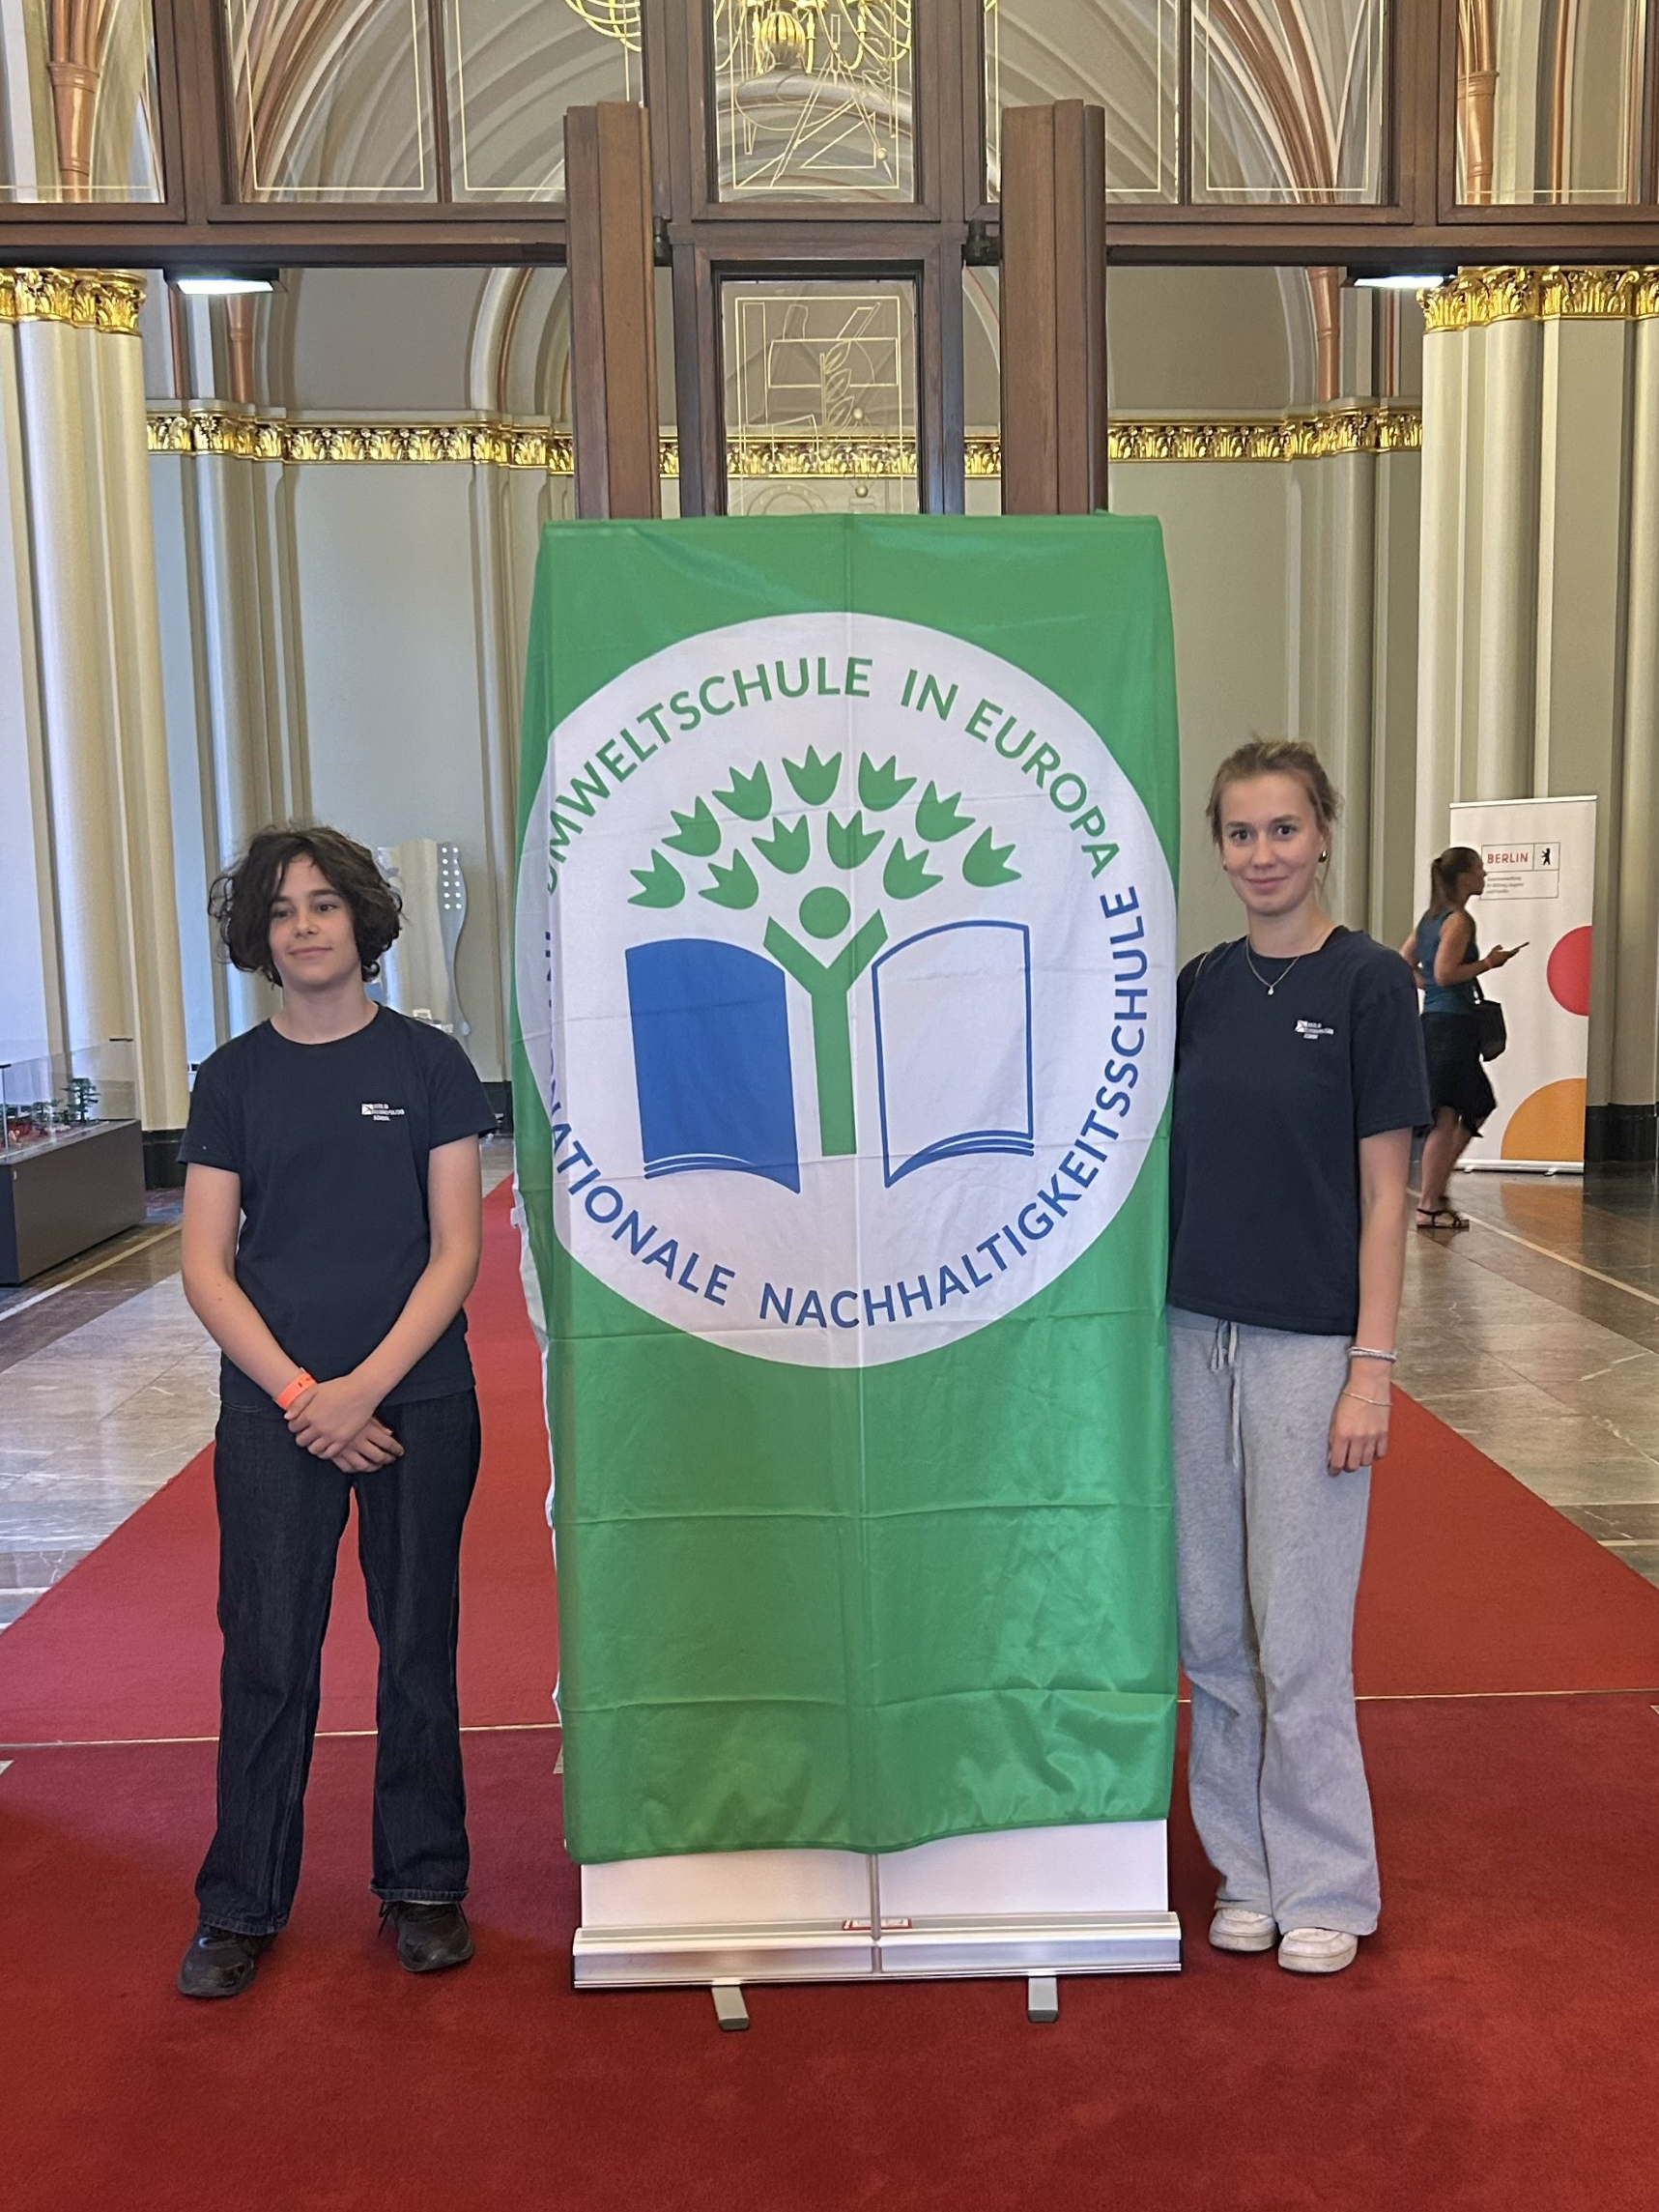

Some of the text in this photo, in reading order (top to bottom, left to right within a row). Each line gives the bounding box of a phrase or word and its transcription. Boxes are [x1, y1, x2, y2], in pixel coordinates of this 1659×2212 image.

[901, 669, 959, 721] IN
[964, 698, 1120, 879] EUROPA
[1487, 852, 1529, 864] BERLIN
[758, 885, 1148, 1329] NACHHALTIGKEITSSCHULE
